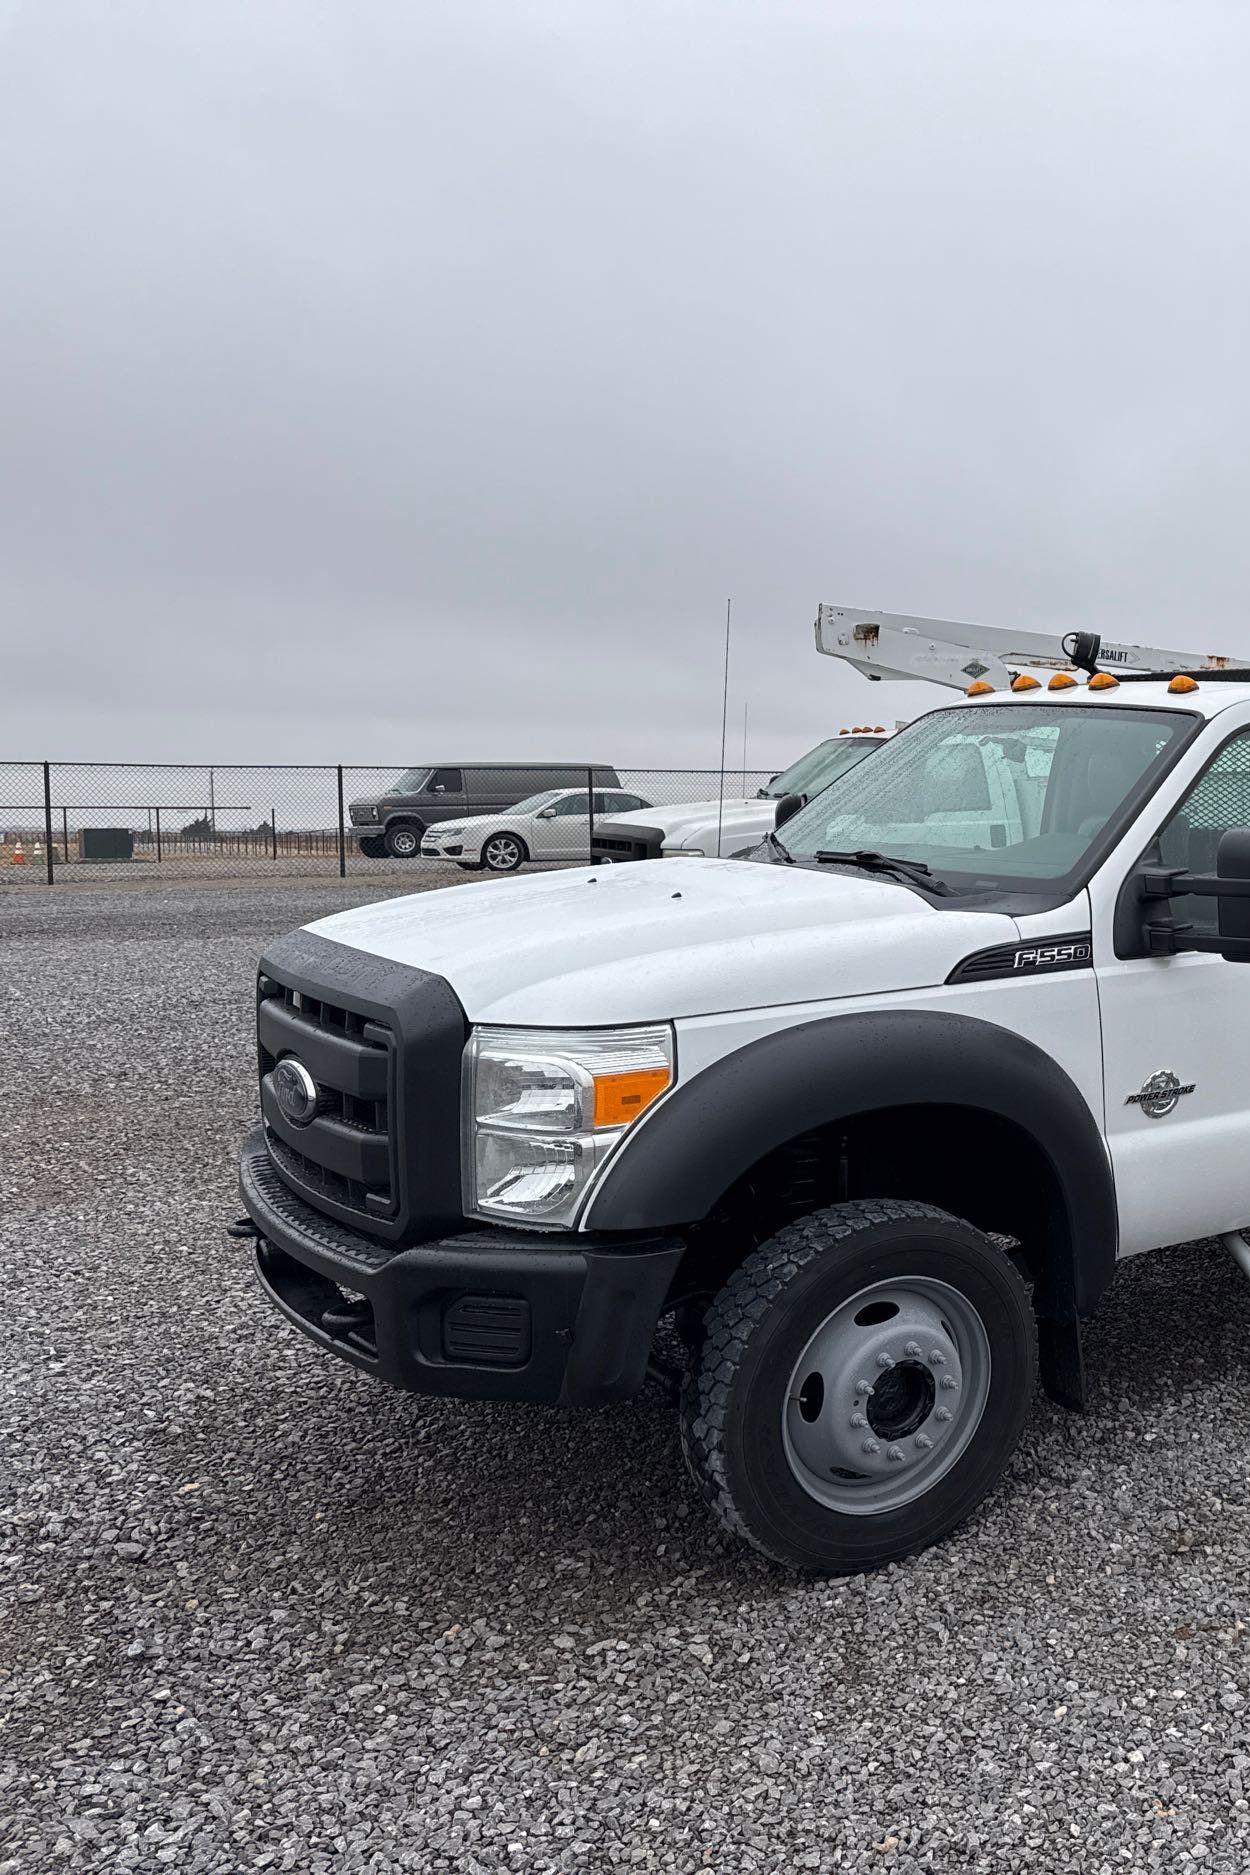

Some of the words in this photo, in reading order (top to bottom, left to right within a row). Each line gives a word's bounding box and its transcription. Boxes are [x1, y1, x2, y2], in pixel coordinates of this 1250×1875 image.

[1098, 649, 1128, 662] ERSALIFT
[1125, 1092, 1160, 1105] POWER
[1160, 1084, 1196, 1098] STROKE
